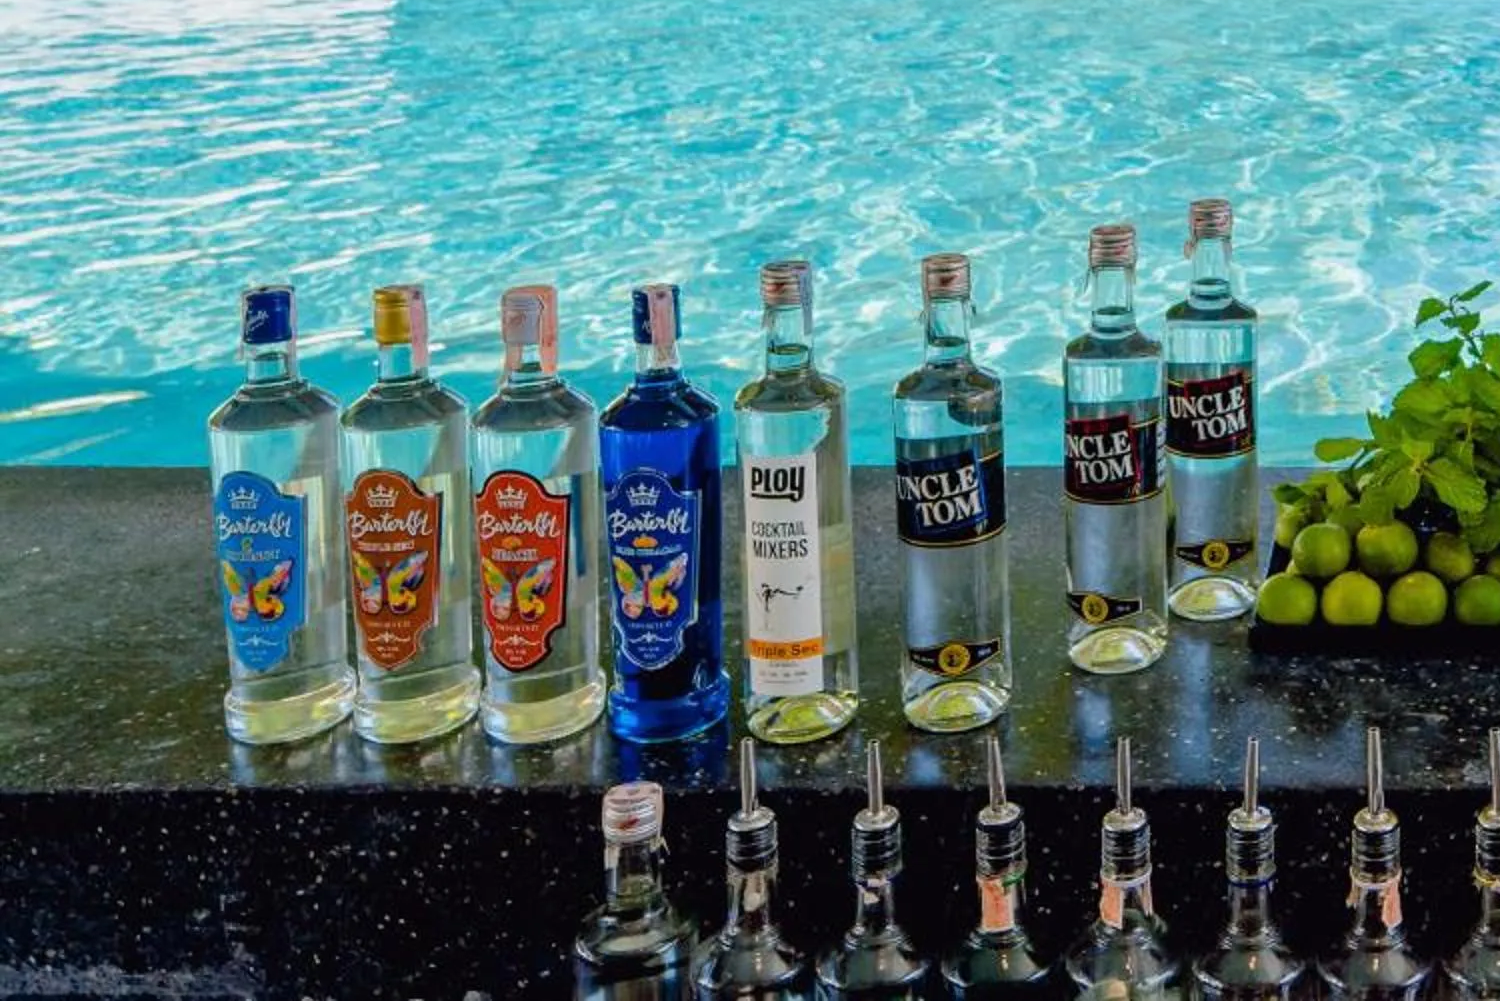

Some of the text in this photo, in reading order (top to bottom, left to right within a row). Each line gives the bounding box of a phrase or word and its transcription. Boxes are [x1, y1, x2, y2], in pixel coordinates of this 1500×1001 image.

[1169, 386, 1246, 419] UNCLE
[1192, 413, 1248, 441] TOM
[1066, 430, 1132, 459] NCLE
[897, 465, 978, 500] UNCLE
[1075, 453, 1133, 483] TOM
[915, 489, 982, 526] TOM
[752, 521, 807, 538] COCKTAIL
[753, 538, 809, 560] MIXERS
